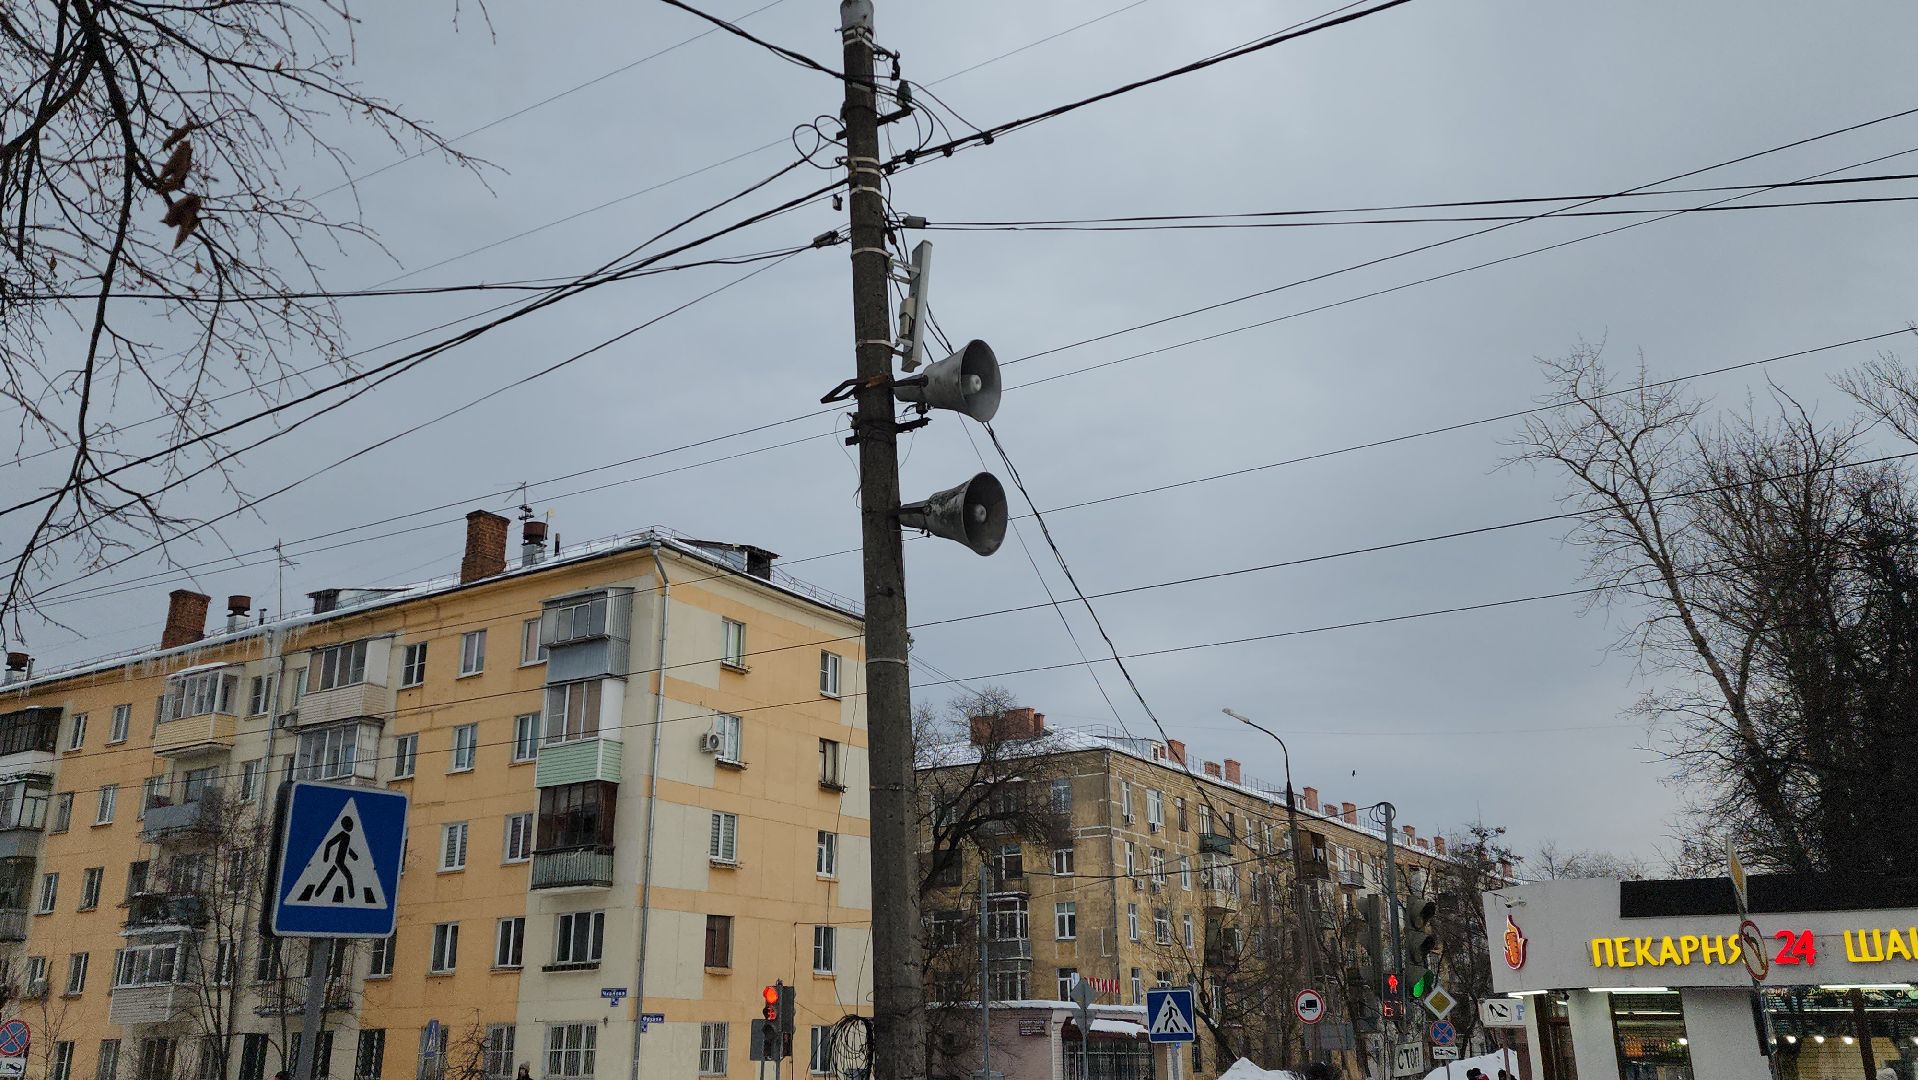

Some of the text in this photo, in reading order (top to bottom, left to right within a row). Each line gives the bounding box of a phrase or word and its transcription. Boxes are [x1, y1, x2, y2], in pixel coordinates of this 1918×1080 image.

[1591, 934, 1741, 967] ПЕКАРНЯ
[1775, 930, 1816, 965] 24
[1084, 976, 1121, 993] ПТИКА
[1398, 1047, 1419, 1069] СТОП
